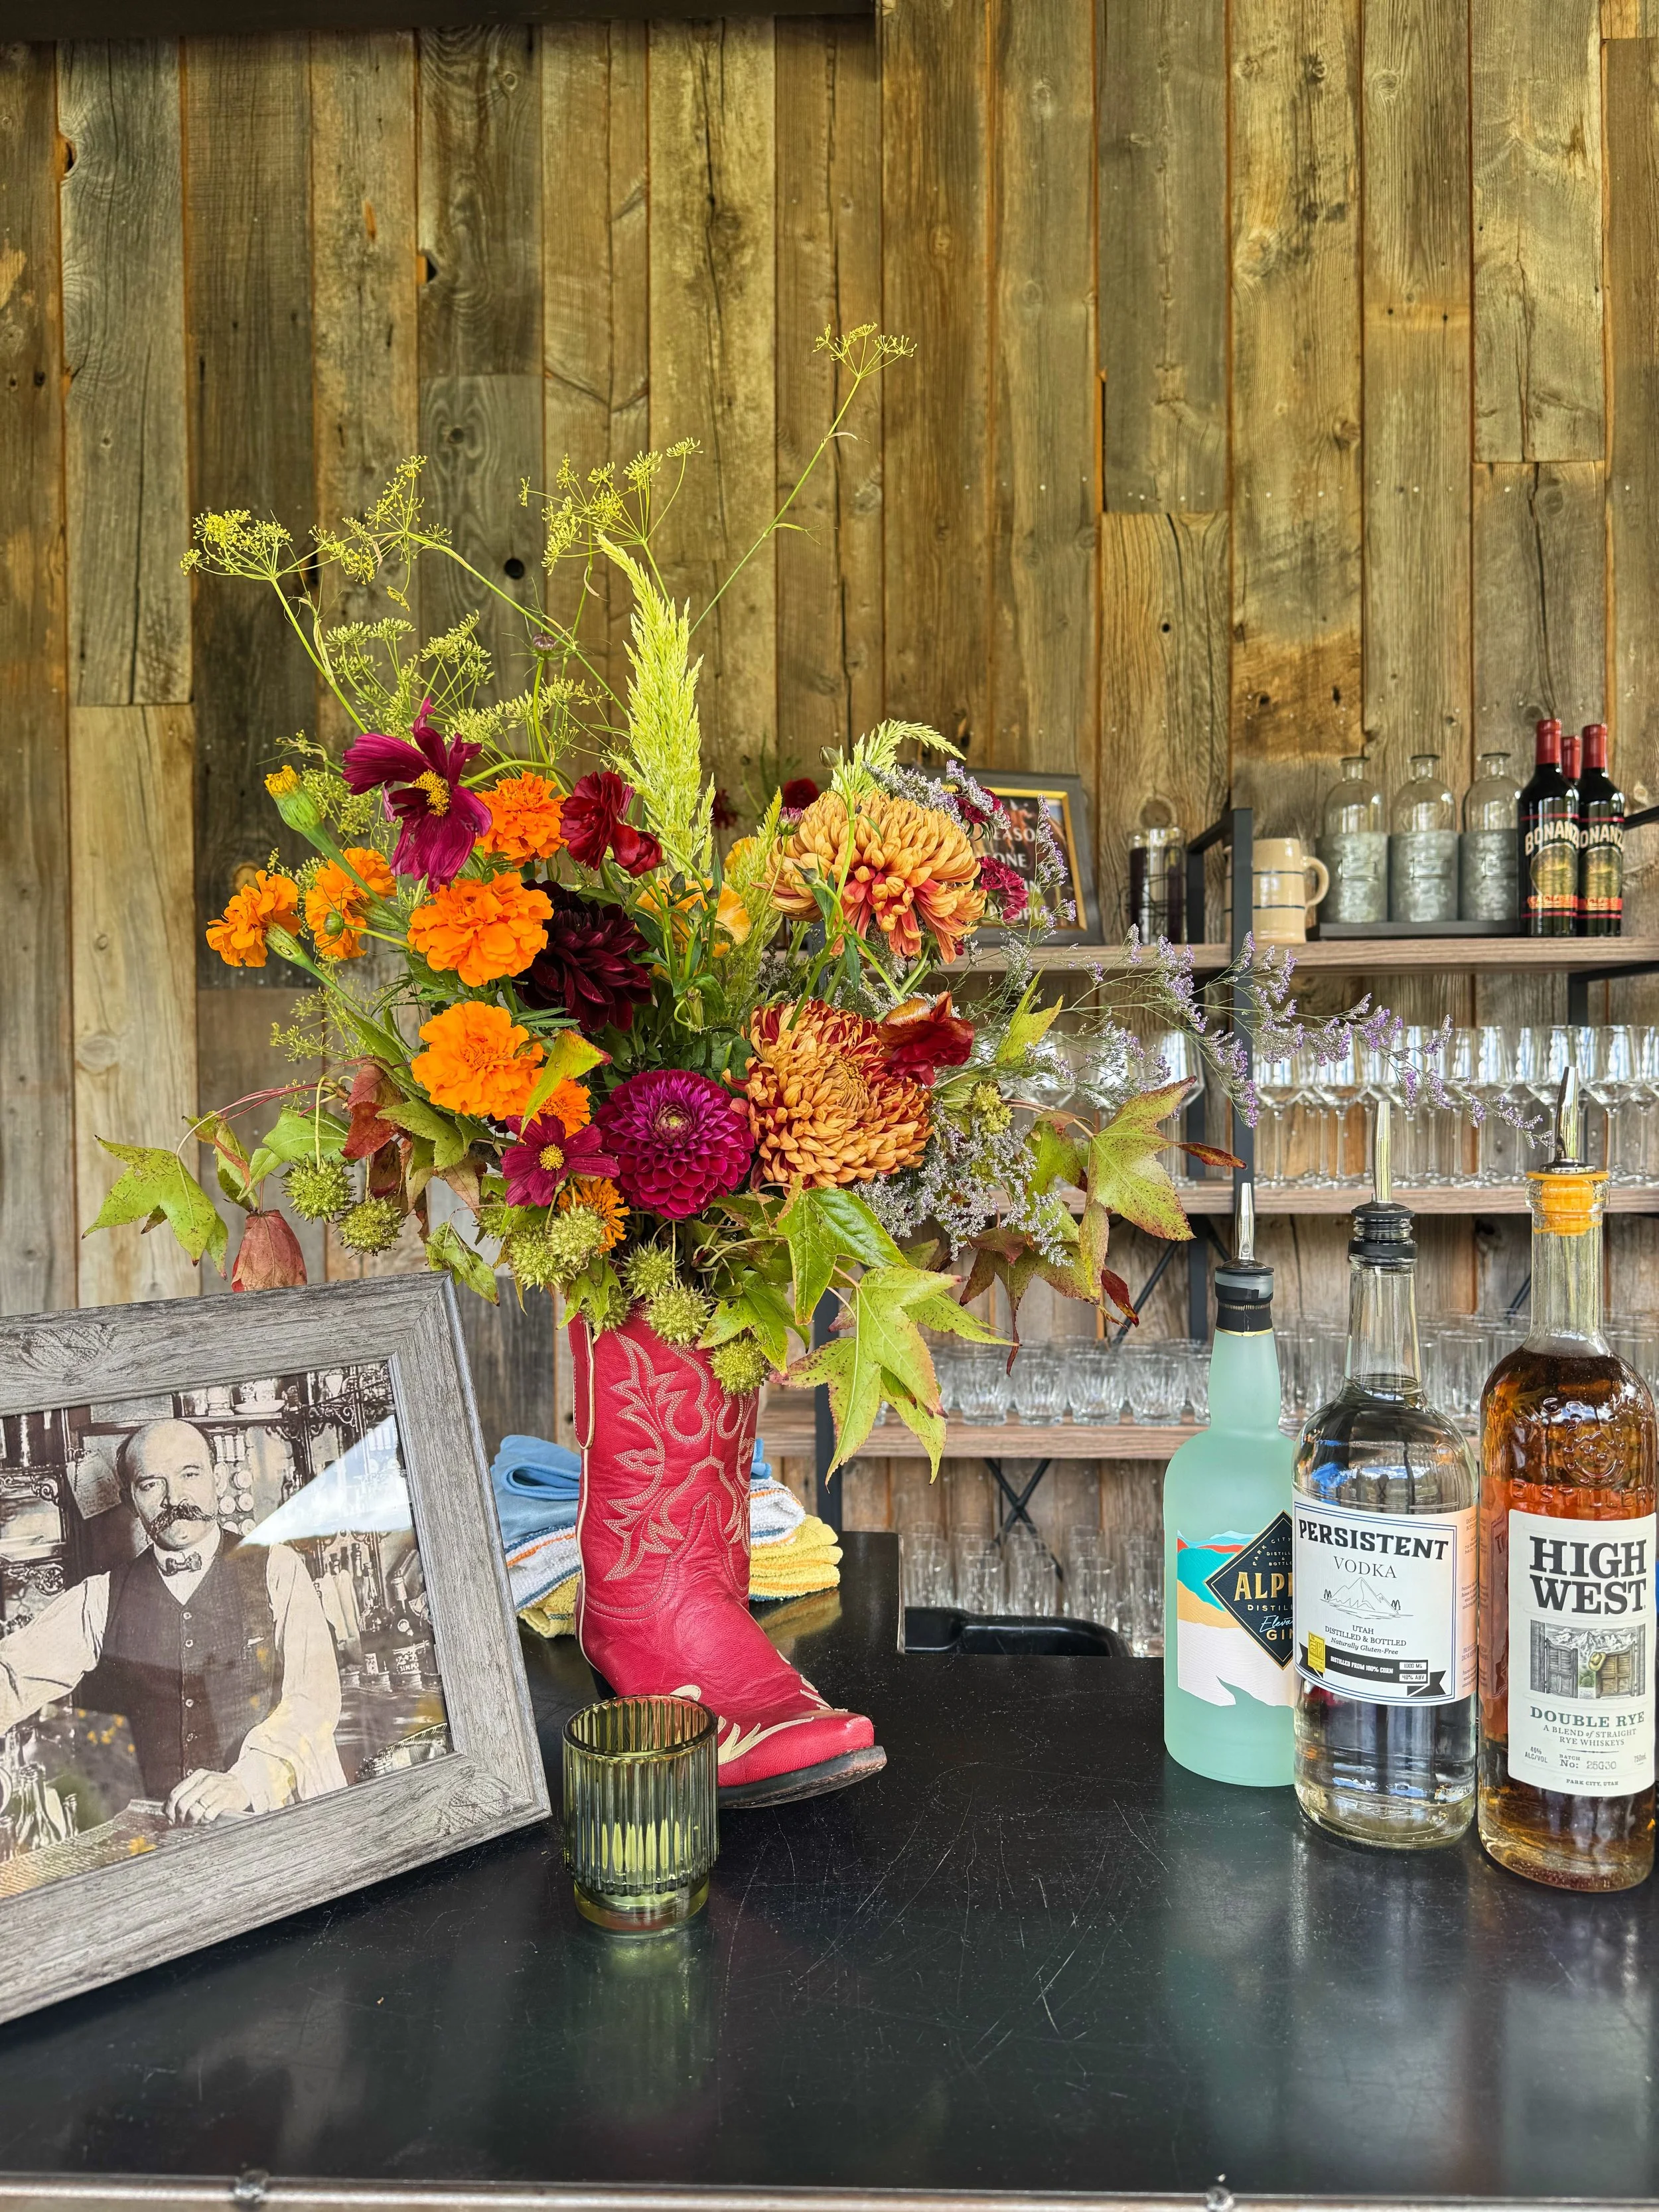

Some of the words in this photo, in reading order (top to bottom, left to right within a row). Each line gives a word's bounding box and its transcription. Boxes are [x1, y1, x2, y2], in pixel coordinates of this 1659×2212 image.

[1525, 820, 1579, 856] BONANZ
[1299, 1518, 1449, 1560] PERSISTENT
[1252, 1545, 1267, 1566] PARK
[1530, 1535, 1647, 1579] HIGH
[1333, 1556, 1397, 1578] VODKA
[1530, 1574, 1646, 1615] WEST
[1325, 1626, 1361, 1641] DISTILLED
[1370, 1637, 1407, 1646] BOTTLED
[1352, 1625, 1374, 1634] UTAH
[1331, 1638, 1359, 1651] Naturally
[1360, 1645, 1399, 1655] Gluten-Free
[1331, 1656, 1350, 1666] DISTILLED
[1530, 1706, 1609, 1728] DOUBLE
[1616, 1711, 1644, 1727] RYE
[1552, 1726, 1583, 1737] BLEND
[1586, 1730, 1594, 1739] of
[1596, 1728, 1636, 1738] STRAIGHT
[1559, 1736, 1577, 1745] RYE
[1524, 1751, 1548, 1763] ALC/VOL
[1559, 1759, 1579, 1769] No:
